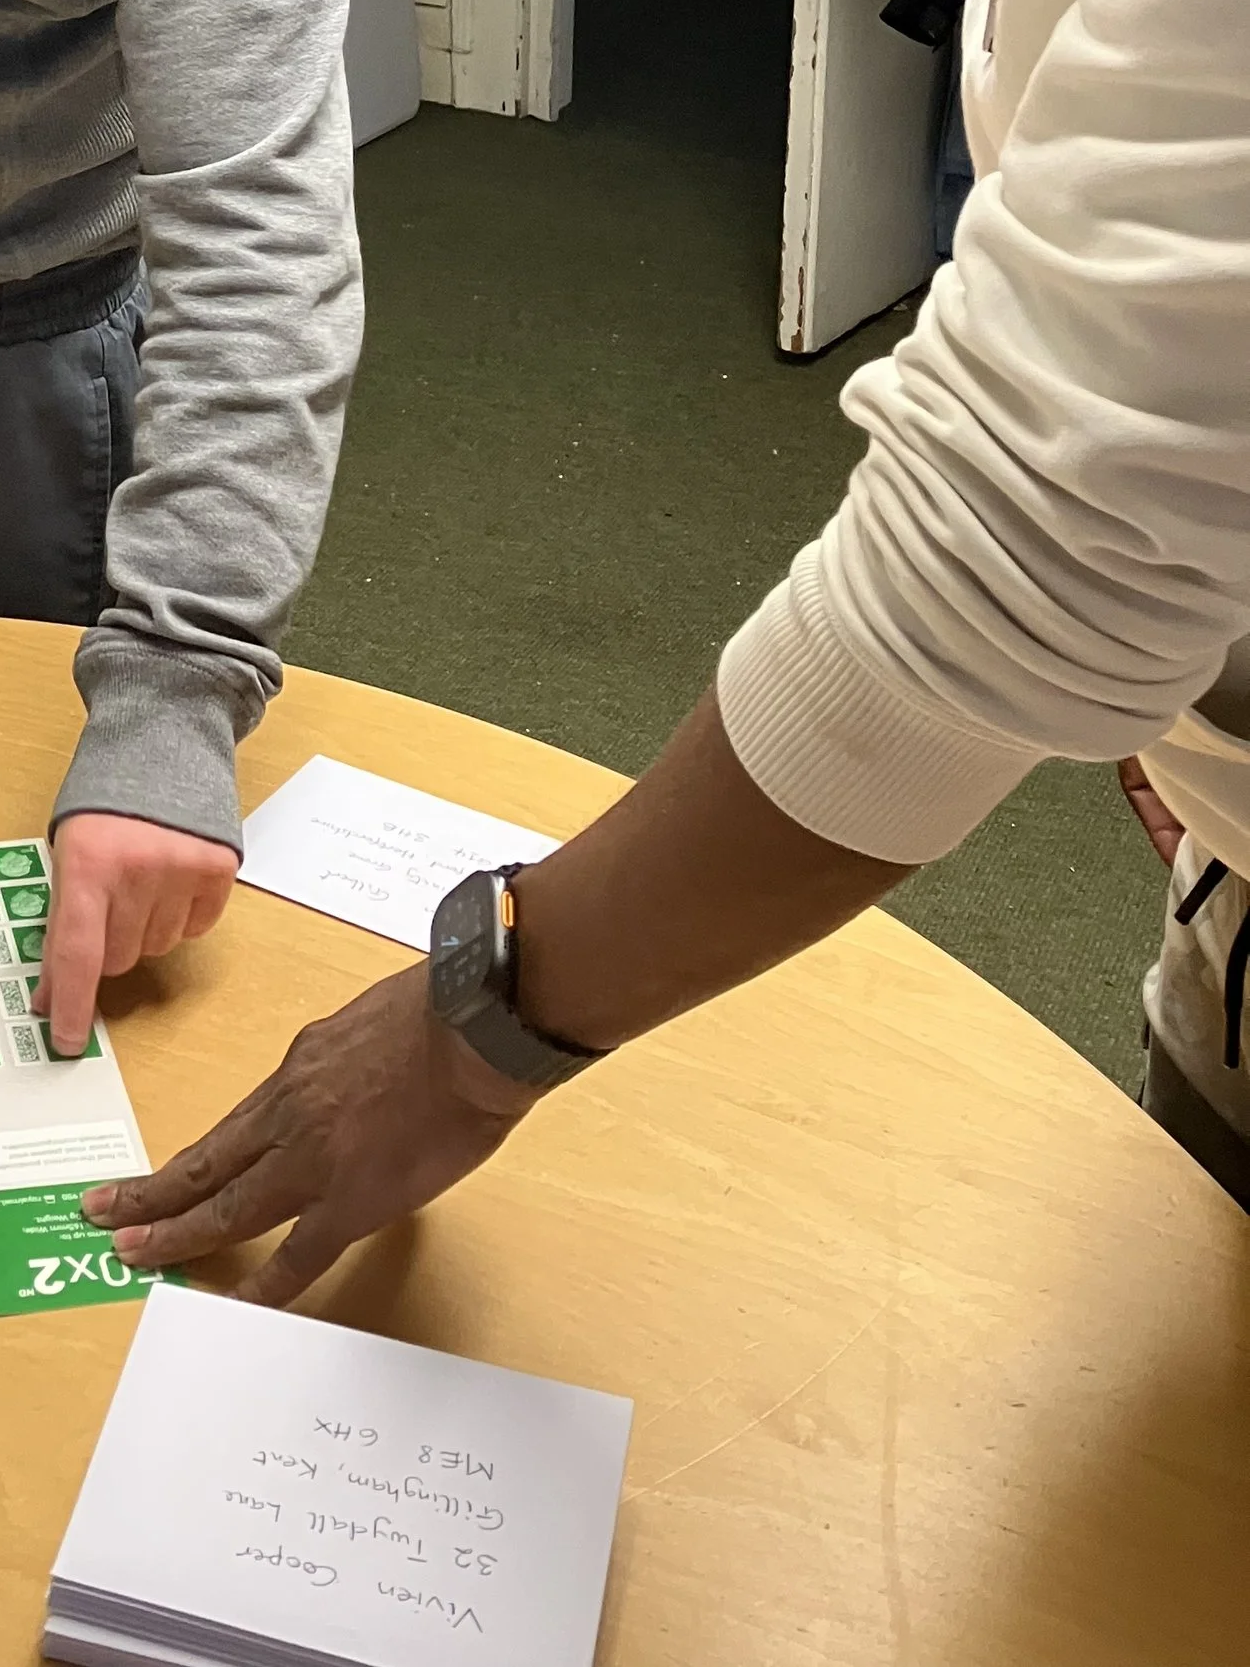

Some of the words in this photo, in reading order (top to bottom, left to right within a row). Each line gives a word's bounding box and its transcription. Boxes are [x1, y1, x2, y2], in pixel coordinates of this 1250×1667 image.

[313, 1416, 378, 1446] 6HX
[252, 1449, 317, 1480] Kent
[419, 1443, 494, 1480] ME8
[223, 1488, 281, 1523] Lane
[339, 1461, 504, 1531] Gillingham,
[309, 1511, 427, 1563] Twydall
[235, 1545, 337, 1587] Cooper
[454, 1545, 498, 1576] 32
